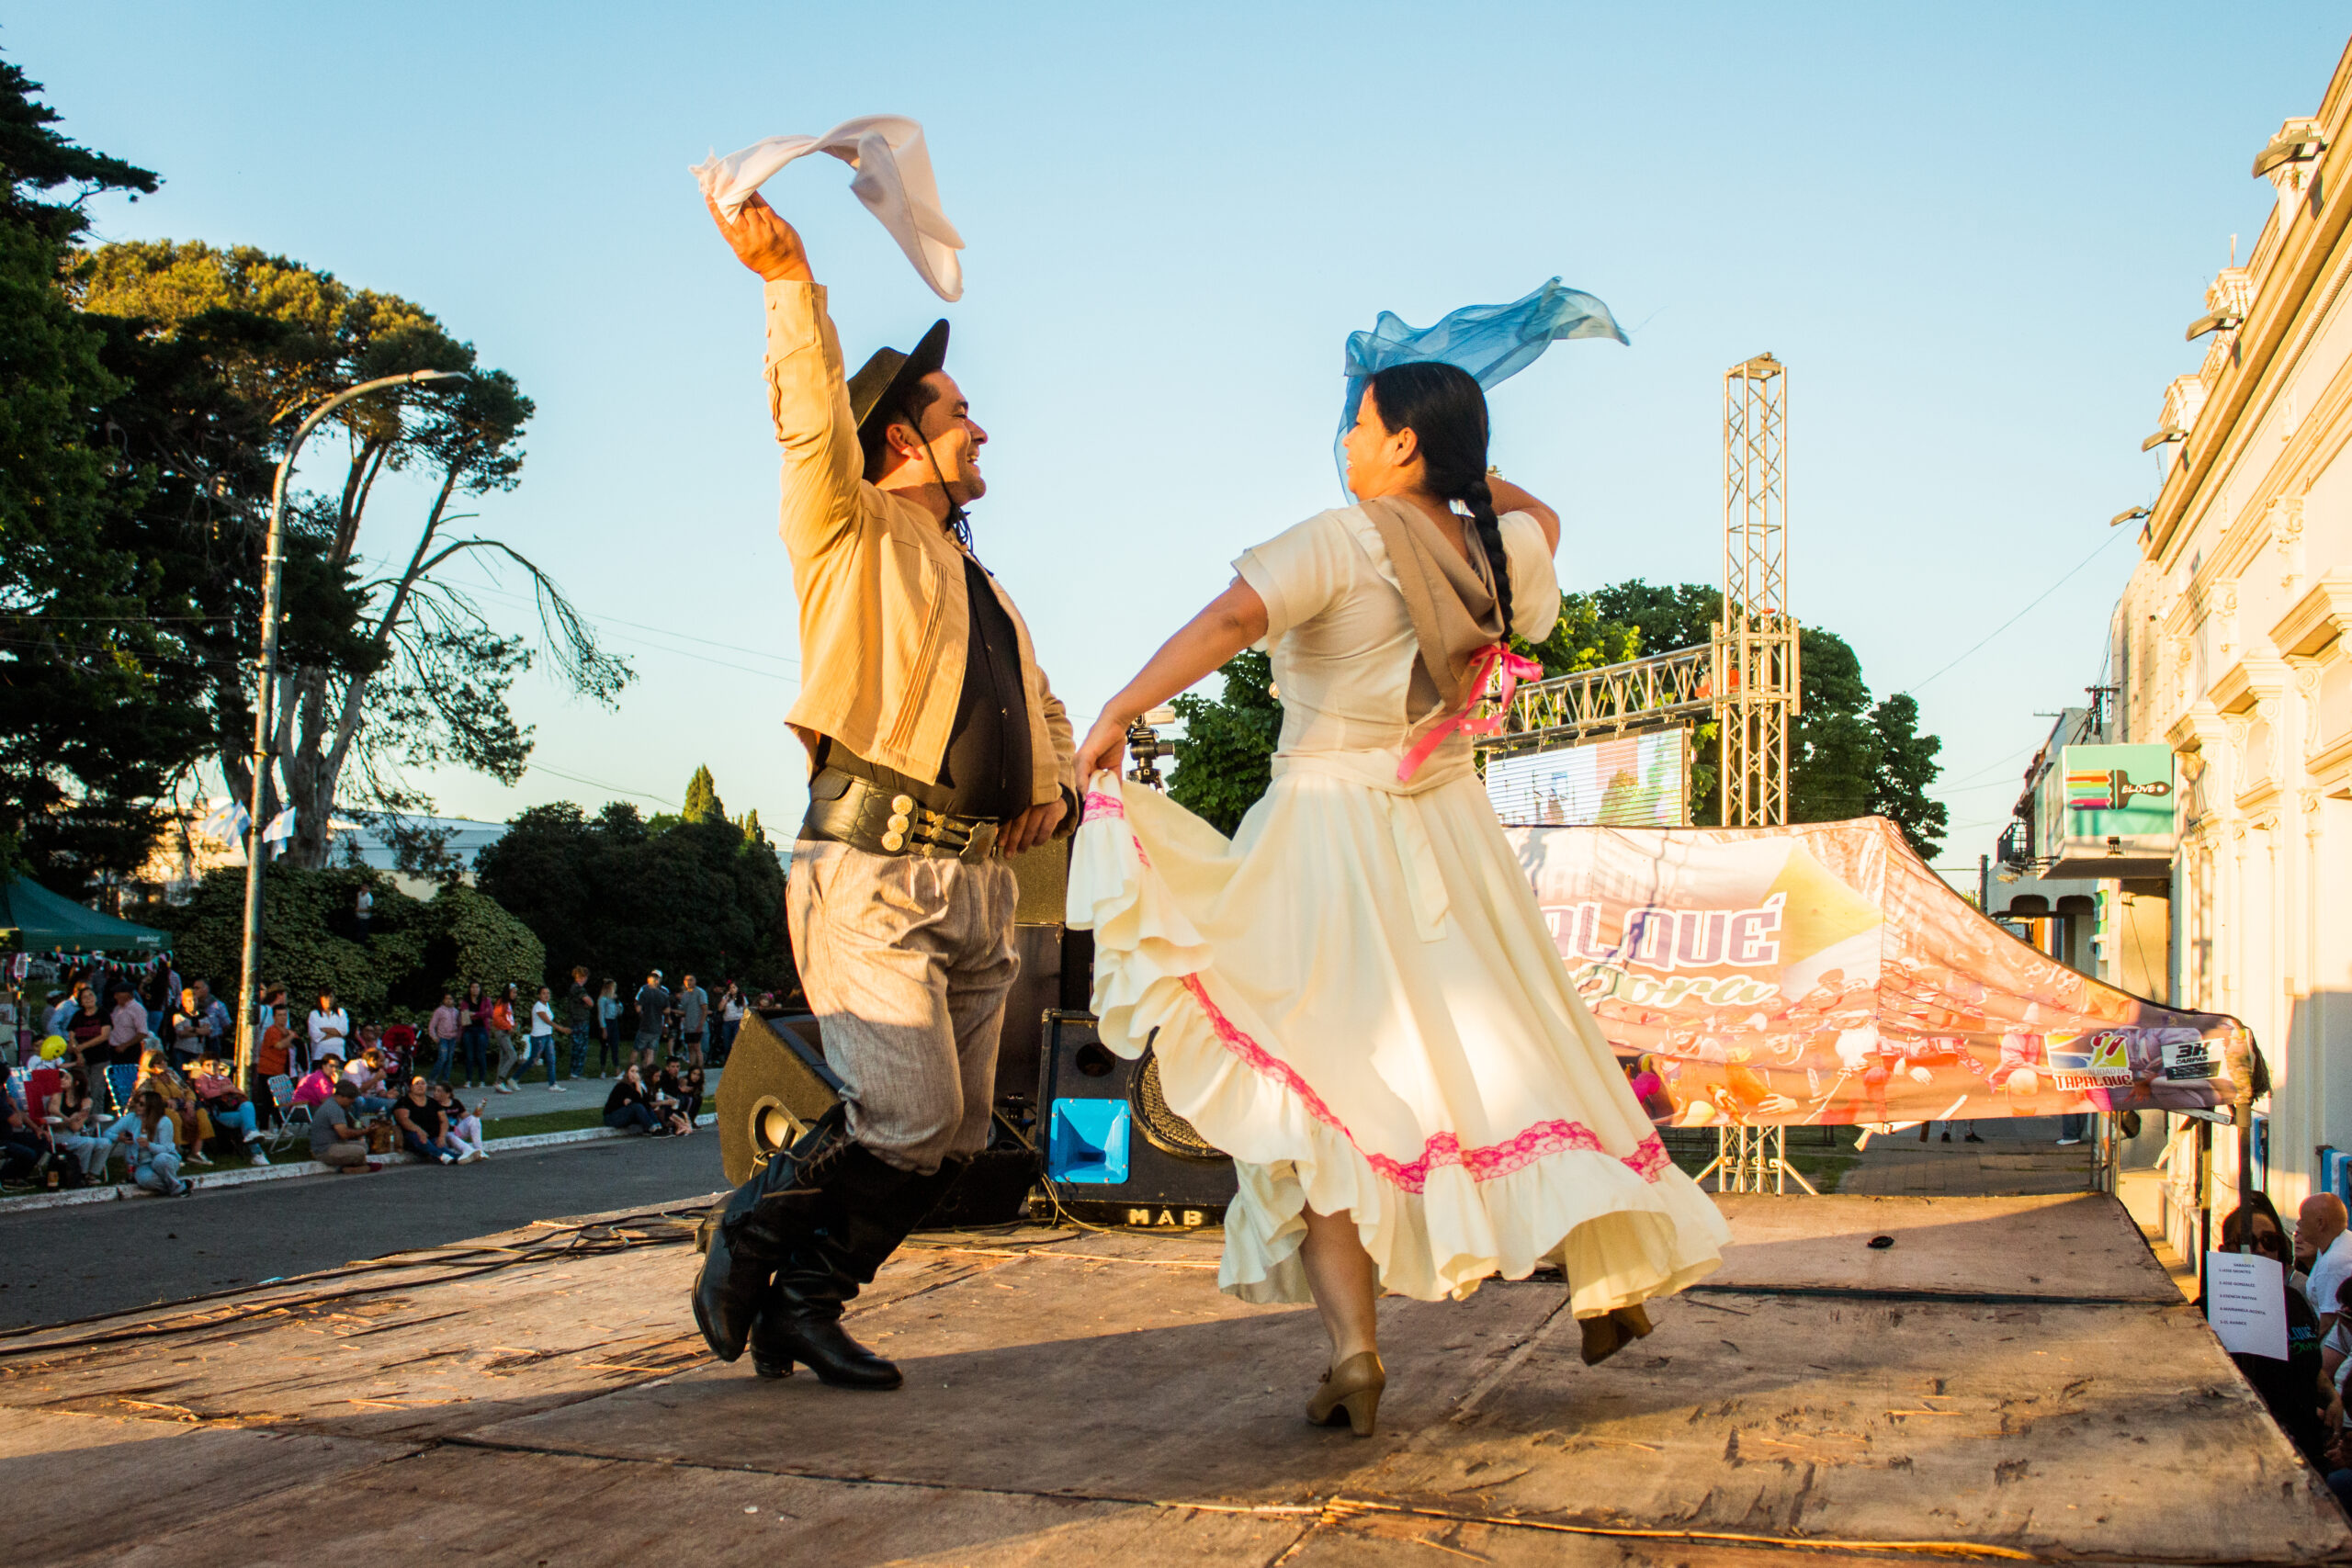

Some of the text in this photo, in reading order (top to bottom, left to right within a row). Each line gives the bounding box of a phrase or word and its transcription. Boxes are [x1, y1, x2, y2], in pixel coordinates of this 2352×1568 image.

[2176, 1042, 2211, 1058] 3H
[2176, 1055, 2209, 1065] CARPAS
[1129, 1209, 1203, 1226] MAB
